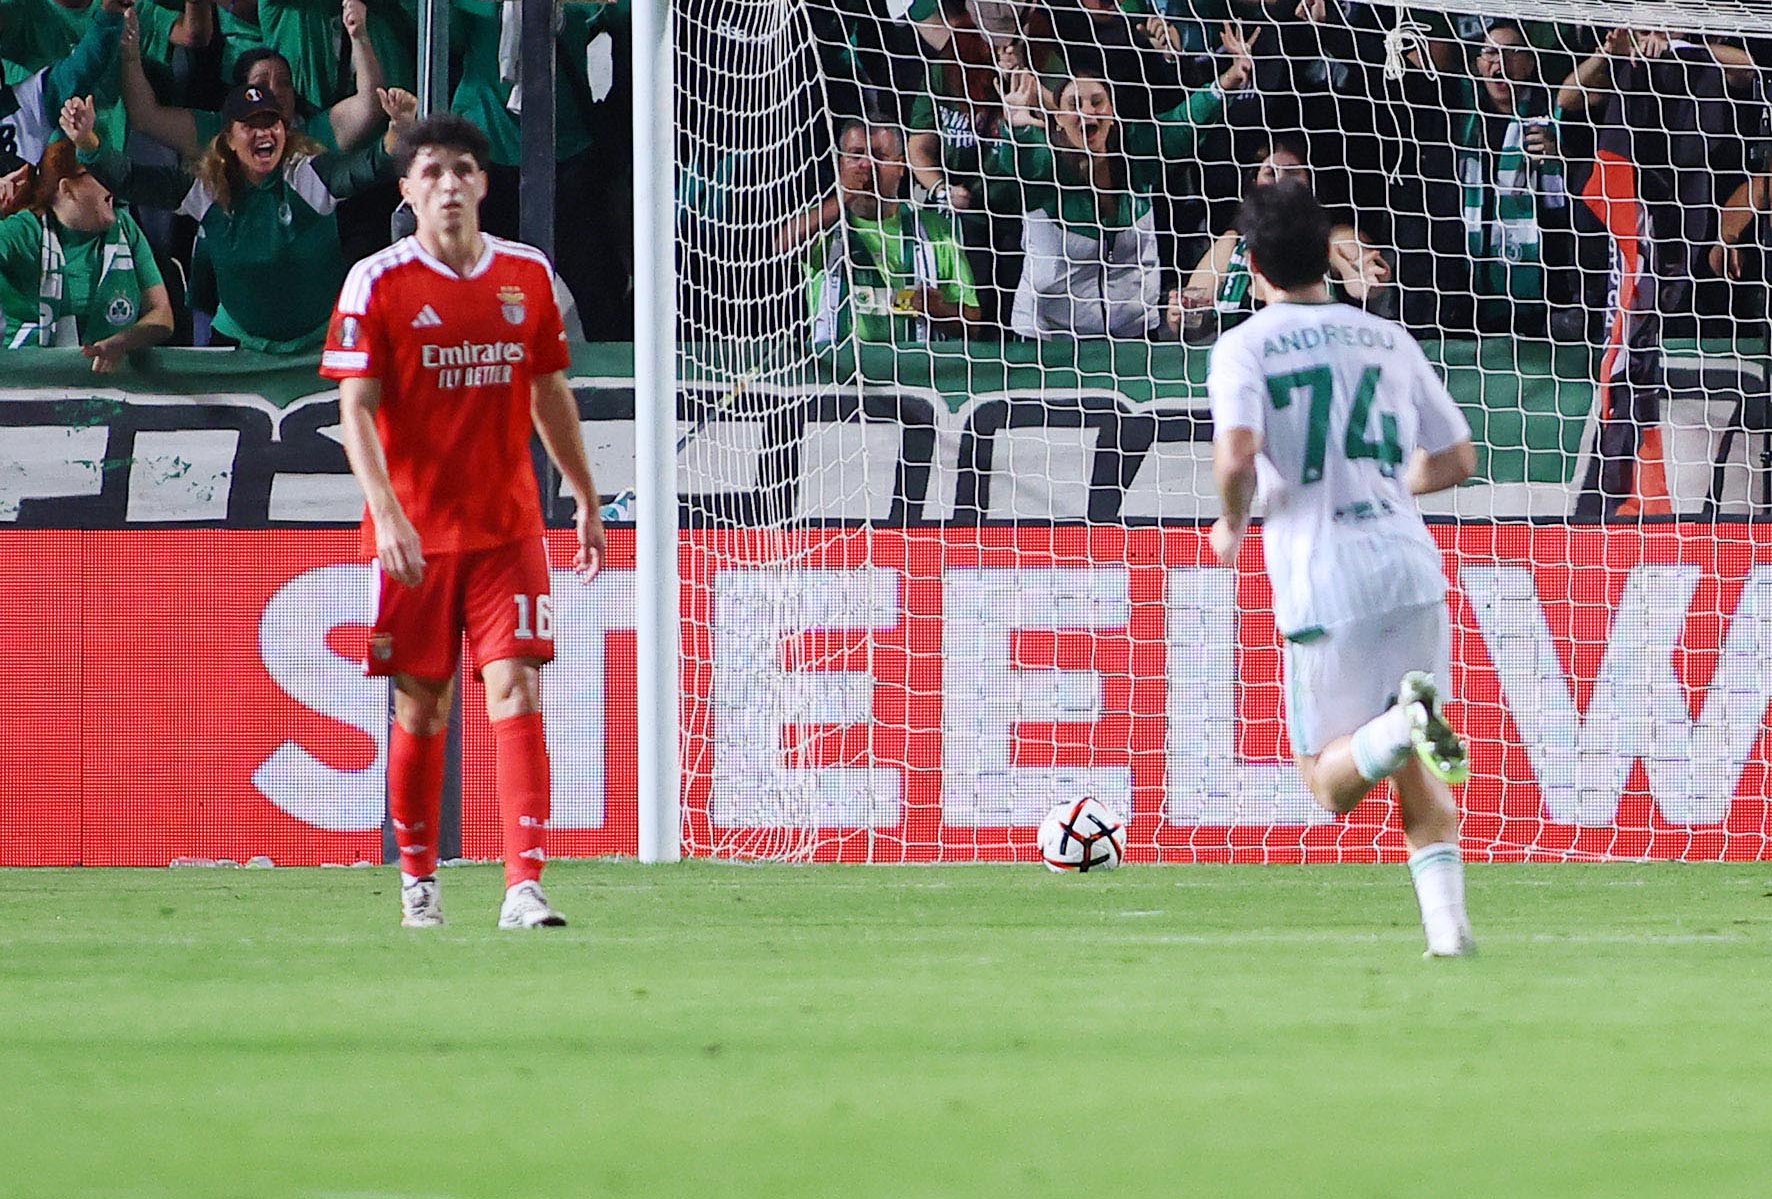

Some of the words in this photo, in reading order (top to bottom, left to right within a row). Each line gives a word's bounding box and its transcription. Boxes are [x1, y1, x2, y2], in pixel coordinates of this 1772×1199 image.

[421, 340, 525, 368] Emirates
[1263, 323, 1394, 358] ANDREOU
[1264, 363, 1403, 485] 74
[513, 594, 554, 641] 16
